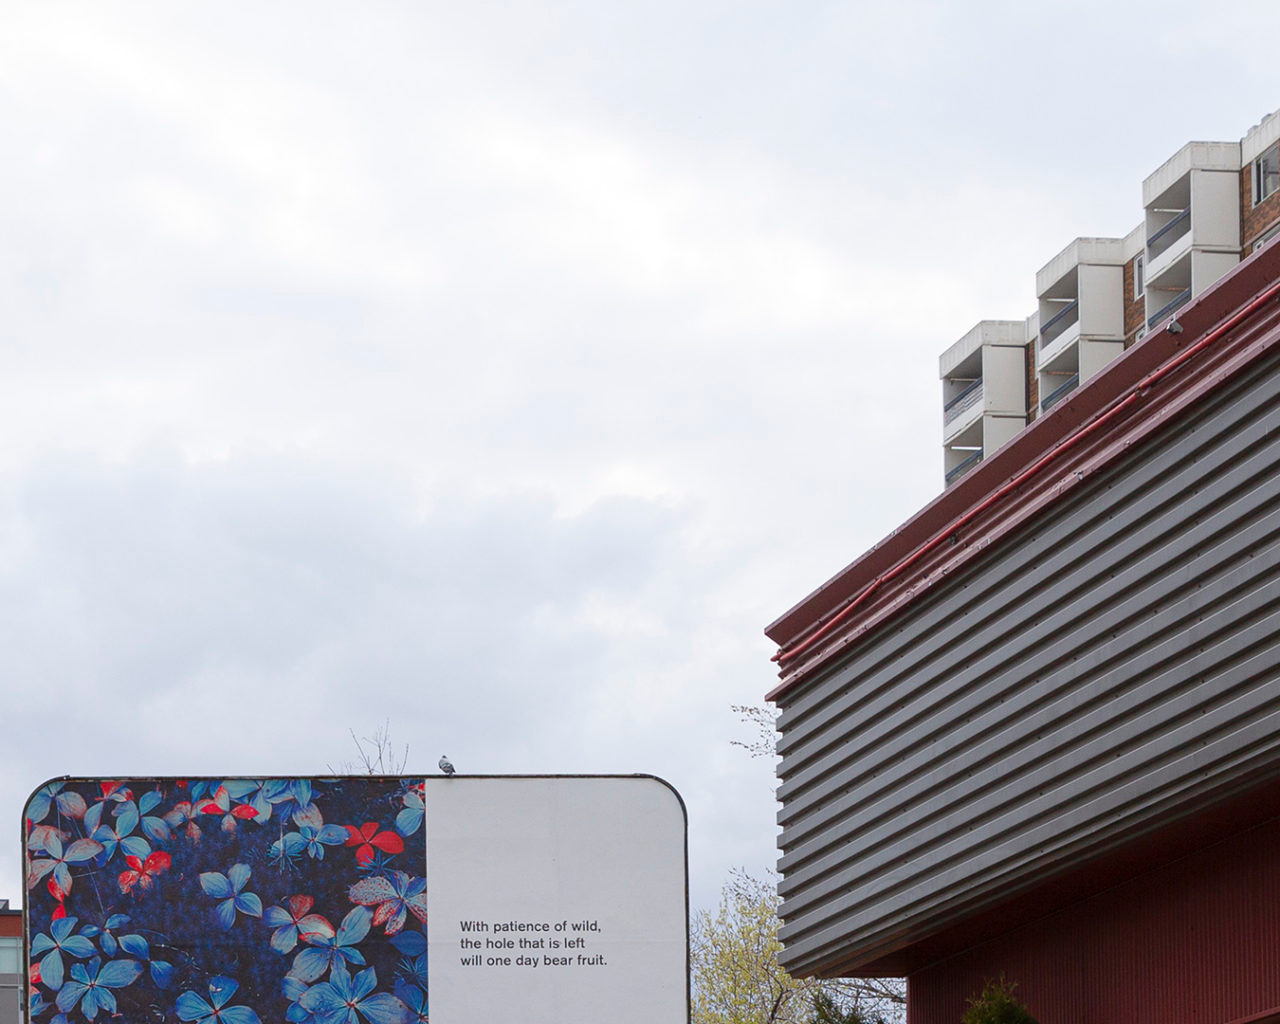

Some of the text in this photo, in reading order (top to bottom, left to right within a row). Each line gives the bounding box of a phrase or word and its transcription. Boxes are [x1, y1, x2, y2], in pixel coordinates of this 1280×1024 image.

[460, 920, 602, 934] With patience of wild,
[460, 938, 585, 949] the hole that is left
[460, 955, 608, 968] will one day bear fruit.
